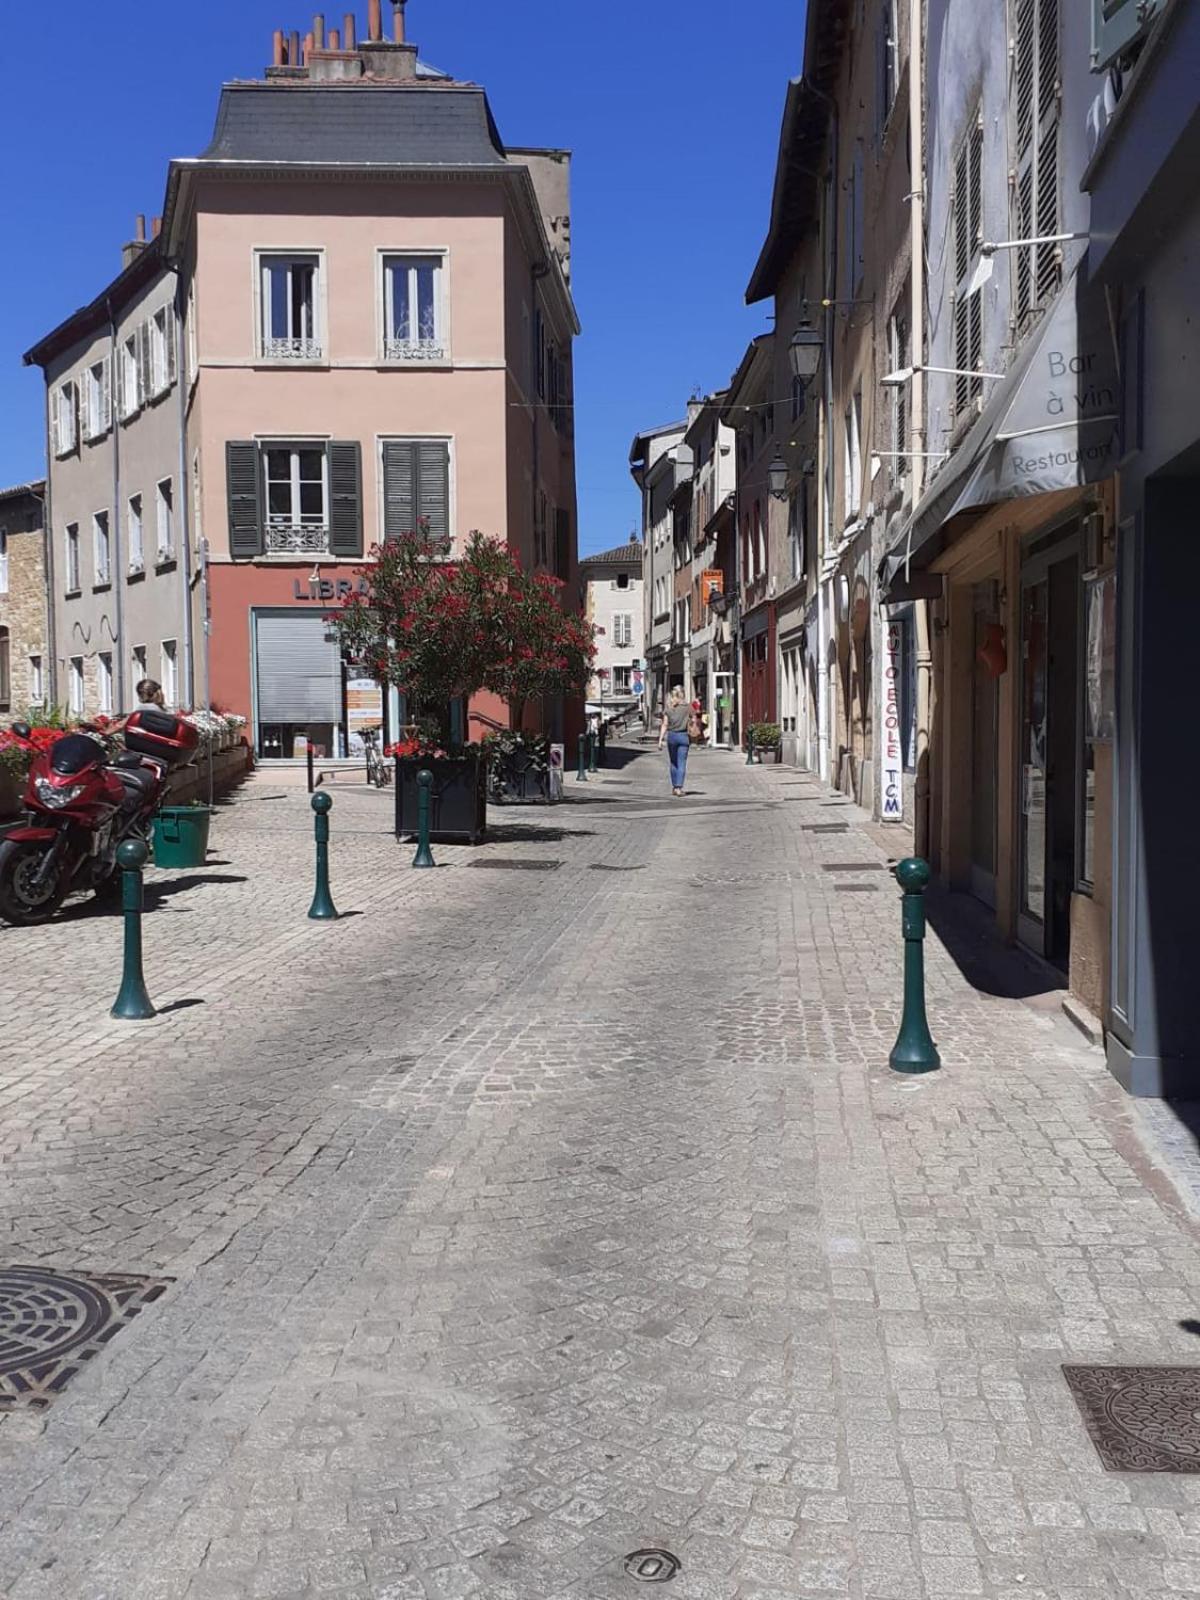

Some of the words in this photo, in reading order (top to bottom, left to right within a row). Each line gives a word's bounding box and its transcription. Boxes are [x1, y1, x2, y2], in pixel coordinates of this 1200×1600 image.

[1047, 351, 1096, 378] Bar
[1046, 390, 1064, 415] à
[1073, 384, 1113, 410] vin
[884, 769, 899, 813] TCM
